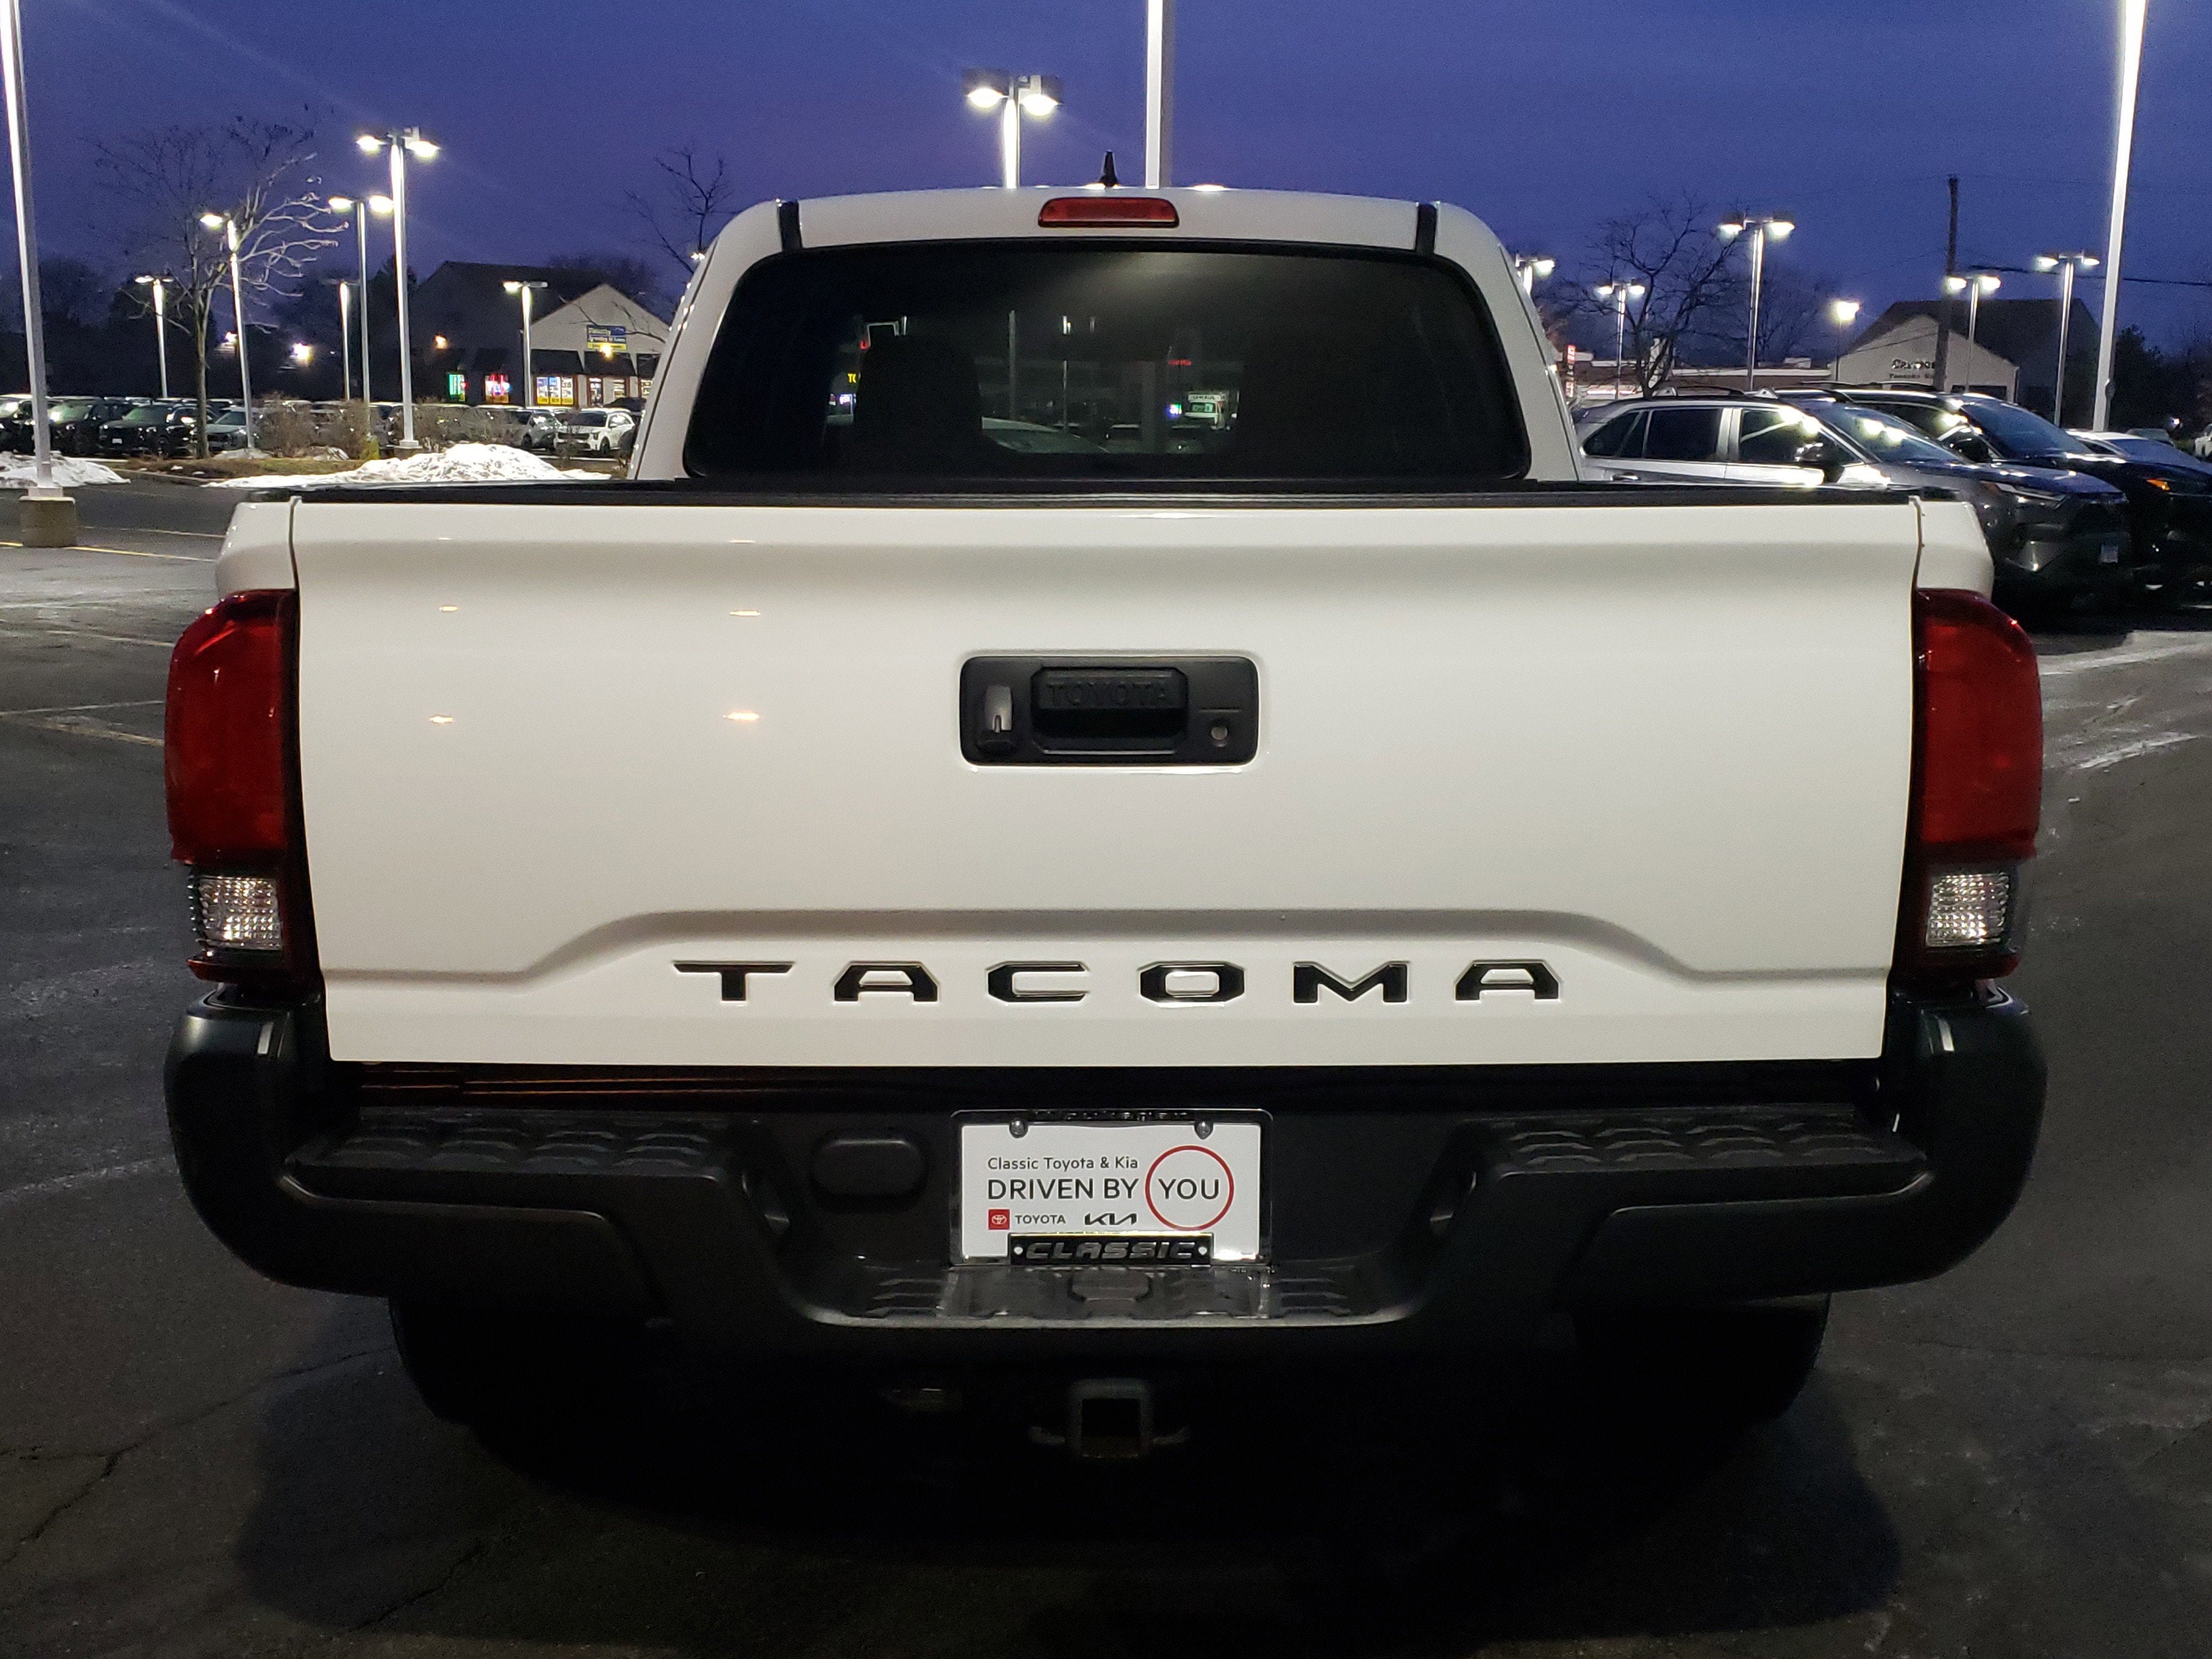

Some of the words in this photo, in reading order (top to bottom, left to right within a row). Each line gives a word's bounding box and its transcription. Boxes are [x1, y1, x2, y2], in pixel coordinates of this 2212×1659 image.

[1046, 680, 1176, 707] TOYOTA
[673, 958, 1560, 1003] TACOMA
[988, 1157, 1039, 1170] Classic
[1043, 1157, 1094, 1172] Toyota
[1100, 1156, 1110, 1169] &
[1115, 1156, 1138, 1169] Kia
[988, 1178, 1094, 1200] DRIVEN
[1104, 1178, 1139, 1199] BY
[1158, 1178, 1219, 1200] YOU
[1015, 1214, 1066, 1224] TOYOTA
[1026, 1241, 1196, 1260] CLASSIC
